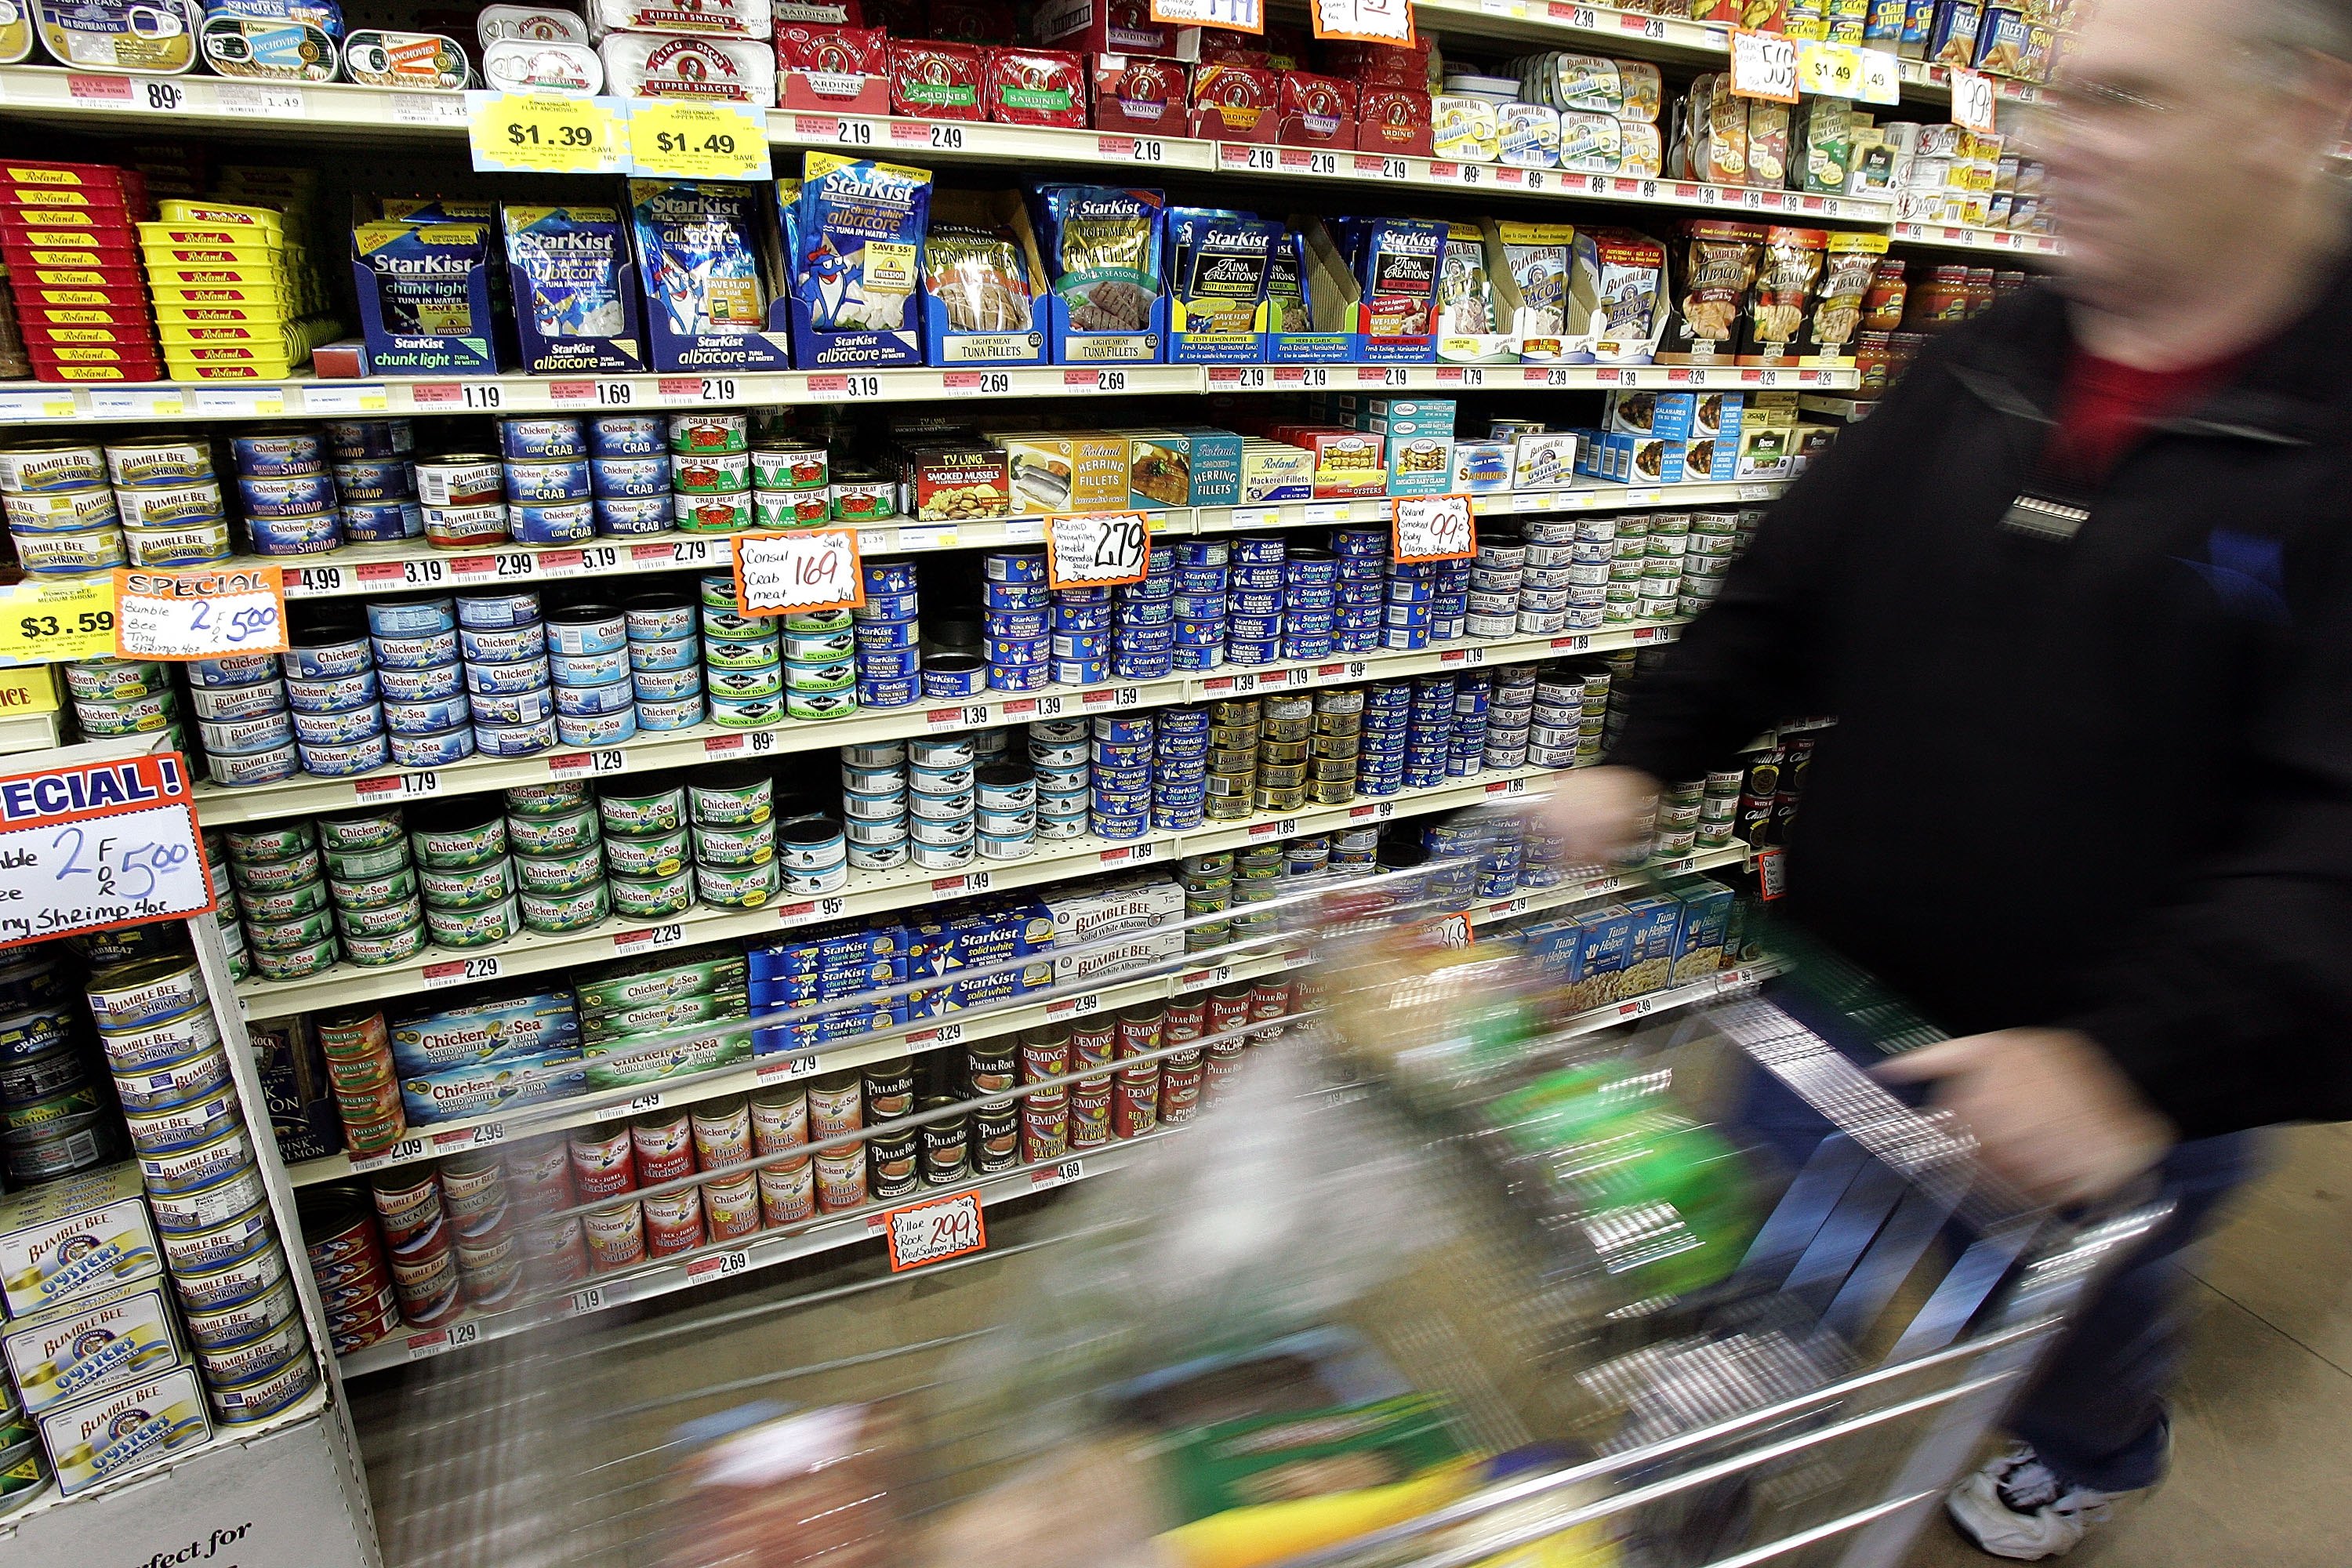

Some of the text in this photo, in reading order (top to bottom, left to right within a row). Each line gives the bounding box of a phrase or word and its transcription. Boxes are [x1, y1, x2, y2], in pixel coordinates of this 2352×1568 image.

[62, 18, 120, 32] IN SOYBEAN OIL
[1573, 9, 1594, 29] 2.39
[1998, 20, 2025, 38] TREET
[253, 35, 301, 54] ANCHOVIES
[656, 40, 728, 66] KING OSCAR
[1815, 63, 1850, 79] $1.49
[147, 84, 182, 109] 89¢
[652, 82, 734, 94] KIPPER SNACKS
[267, 97, 299, 107] 1.49
[1009, 94, 1063, 107] SARDINES
[508, 124, 593, 145] $1.39
[839, 122, 870, 144] 2.19
[932, 126, 961, 149] 2.49
[657, 132, 735, 153] $1.49
[1134, 140, 1160, 161] 2.19
[1249, 149, 1273, 169] 2.19
[25, 171, 64, 182] Roland
[1464, 165, 1480, 183] 89¢
[822, 173, 916, 202] StarKist
[1699, 188, 1715, 204] 1.39
[1080, 200, 1141, 215] StarKist
[827, 210, 901, 231] albacore
[184, 233, 220, 243] Roland
[836, 225, 855, 235] TUNA
[866, 229, 888, 239] WATER
[1203, 230, 1269, 247] StarKist
[872, 243, 895, 252] SAVE
[374, 253, 474, 274] StarKist
[1218, 258, 1248, 273] TUNA
[1203, 266, 1261, 281] CREATIONS
[60, 311, 95, 322] Roland
[394, 338, 445, 349] StarKist
[551, 343, 595, 355] StarKist
[834, 336, 877, 346] StarKist
[375, 353, 450, 368] chunk light
[961, 346, 1022, 358] TUNA FILLETS
[534, 357, 597, 370] albacore
[72, 367, 107, 378] Roland
[210, 368, 244, 378] Roland
[1385, 369, 1406, 386] 2.19
[1463, 369, 1482, 385] 1.79
[1547, 371, 1566, 385] 2.39
[1619, 371, 1636, 386] 1.39
[1689, 369, 1705, 385] 3.29
[702, 379, 735, 399] 2.19
[848, 376, 878, 396] 3.19
[980, 373, 1008, 392] 2.69
[463, 387, 499, 408] 1.19
[597, 383, 630, 405] 1.69
[545, 444, 573, 456] CRAB
[23, 455, 93, 477] BUMBLE BEE
[58, 469, 91, 479] SHRIMP
[1078, 459, 1124, 473] HERRING
[927, 470, 999, 481] SMOKED MUSSELS
[1080, 475, 1120, 485] FILLETS
[1250, 474, 1308, 485] Mackerel Fillets
[1402, 506, 1425, 516] Roland
[1450, 502, 1461, 510] Sale
[270, 522, 307, 533] Chicken
[674, 542, 706, 560] 2.79
[822, 537, 844, 548] Sale
[1094, 522, 1144, 568] 279
[496, 554, 532, 575] 2.99
[583, 547, 615, 568] 5.19
[405, 561, 441, 582] 3.19
[747, 549, 837, 585] Consul 169
[128, 573, 269, 597] SPECIAL
[302, 568, 339, 590] 4.99
[749, 572, 779, 586] Crab
[754, 590, 787, 601] meat
[125, 601, 169, 616] Bumble
[191, 601, 210, 630] 2
[21, 611, 113, 638] $3.59
[129, 619, 156, 630] Bee
[127, 633, 155, 645] Tiny
[215, 688, 273, 710] BUMBLE BEE
[1113, 688, 1137, 706] 1.59
[79, 704, 160, 720] Chicken Sea
[753, 733, 774, 751] 89¢
[591, 750, 622, 771] 1.29
[0, 762, 182, 818] ECIAL!
[401, 771, 436, 793] 1.79
[1276, 820, 1296, 834] 1.89
[53, 827, 92, 880] 2
[965, 872, 989, 890] 1.49
[822, 899, 844, 916] 95¢
[37, 907, 129, 928] Shrimp
[1076, 902, 1150, 933] BUMBLE BEE
[1657, 911, 1676, 924] Tuna
[652, 924, 681, 944] 2.29
[960, 930, 1018, 947] StarKist
[1648, 924, 1673, 937] Helper
[967, 942, 1014, 956] solid white
[466, 958, 498, 979] 2.29
[1075, 995, 1097, 1011] 2.99
[1636, 999, 1650, 1013] 2.49
[423, 1019, 542, 1050] Chicken Sea
[514, 1033, 538, 1043] TUNA
[937, 1025, 961, 1042] 3.29
[428, 1043, 485, 1058] SOLID WHITE
[1024, 1045, 1068, 1062] DEMING'S
[968, 1054, 996, 1071] PILLAR
[391, 1138, 423, 1158] 2.09
[1058, 1162, 1080, 1178] 4.69
[894, 1210, 969, 1245] Pillar 299
[899, 1234, 924, 1247] Rock
[902, 1244, 947, 1259] Red Salmon
[720, 1253, 746, 1273] 2.69
[43, 1308, 125, 1359] BUMBLE BEE
[447, 1324, 477, 1343] 1.29
[55, 1336, 136, 1388] OYSTERS
[204, 1522, 252, 1559] for
